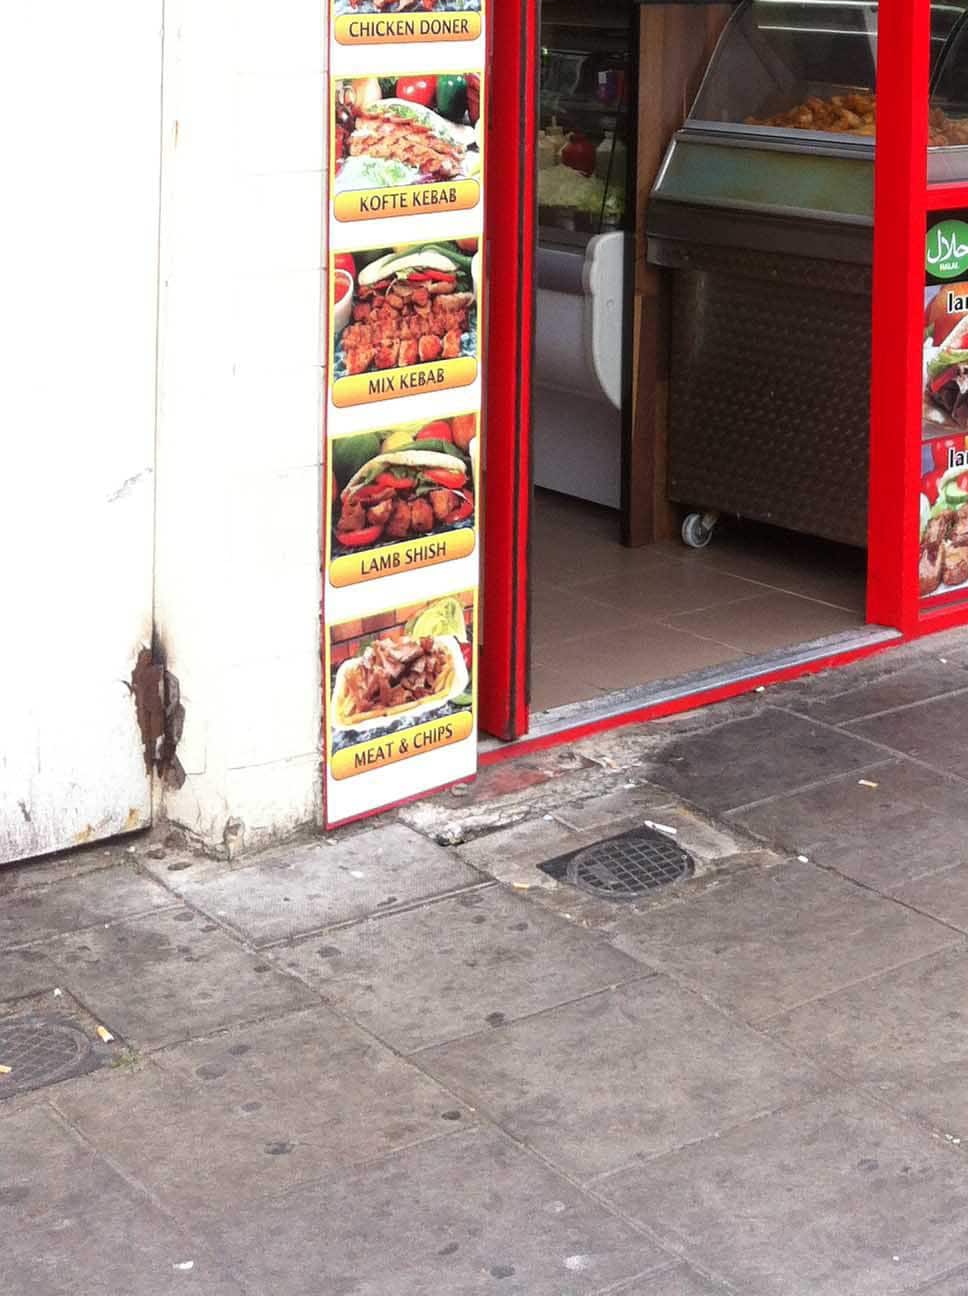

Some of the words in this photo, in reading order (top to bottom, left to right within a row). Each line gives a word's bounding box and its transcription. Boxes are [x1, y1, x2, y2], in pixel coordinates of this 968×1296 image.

[349, 20, 415, 37] CHICKEN
[420, 18, 469, 35] DONER
[359, 193, 407, 212] KOFTE
[412, 187, 457, 207] KEBAB
[368, 375, 395, 395] MIX
[400, 368, 445, 390] KEBAB
[361, 552, 400, 575] LAMB
[405, 542, 447, 564] SHISH
[354, 741, 394, 769] MEAT
[399, 738, 409, 755] &
[413, 723, 453, 749] CHIPS
